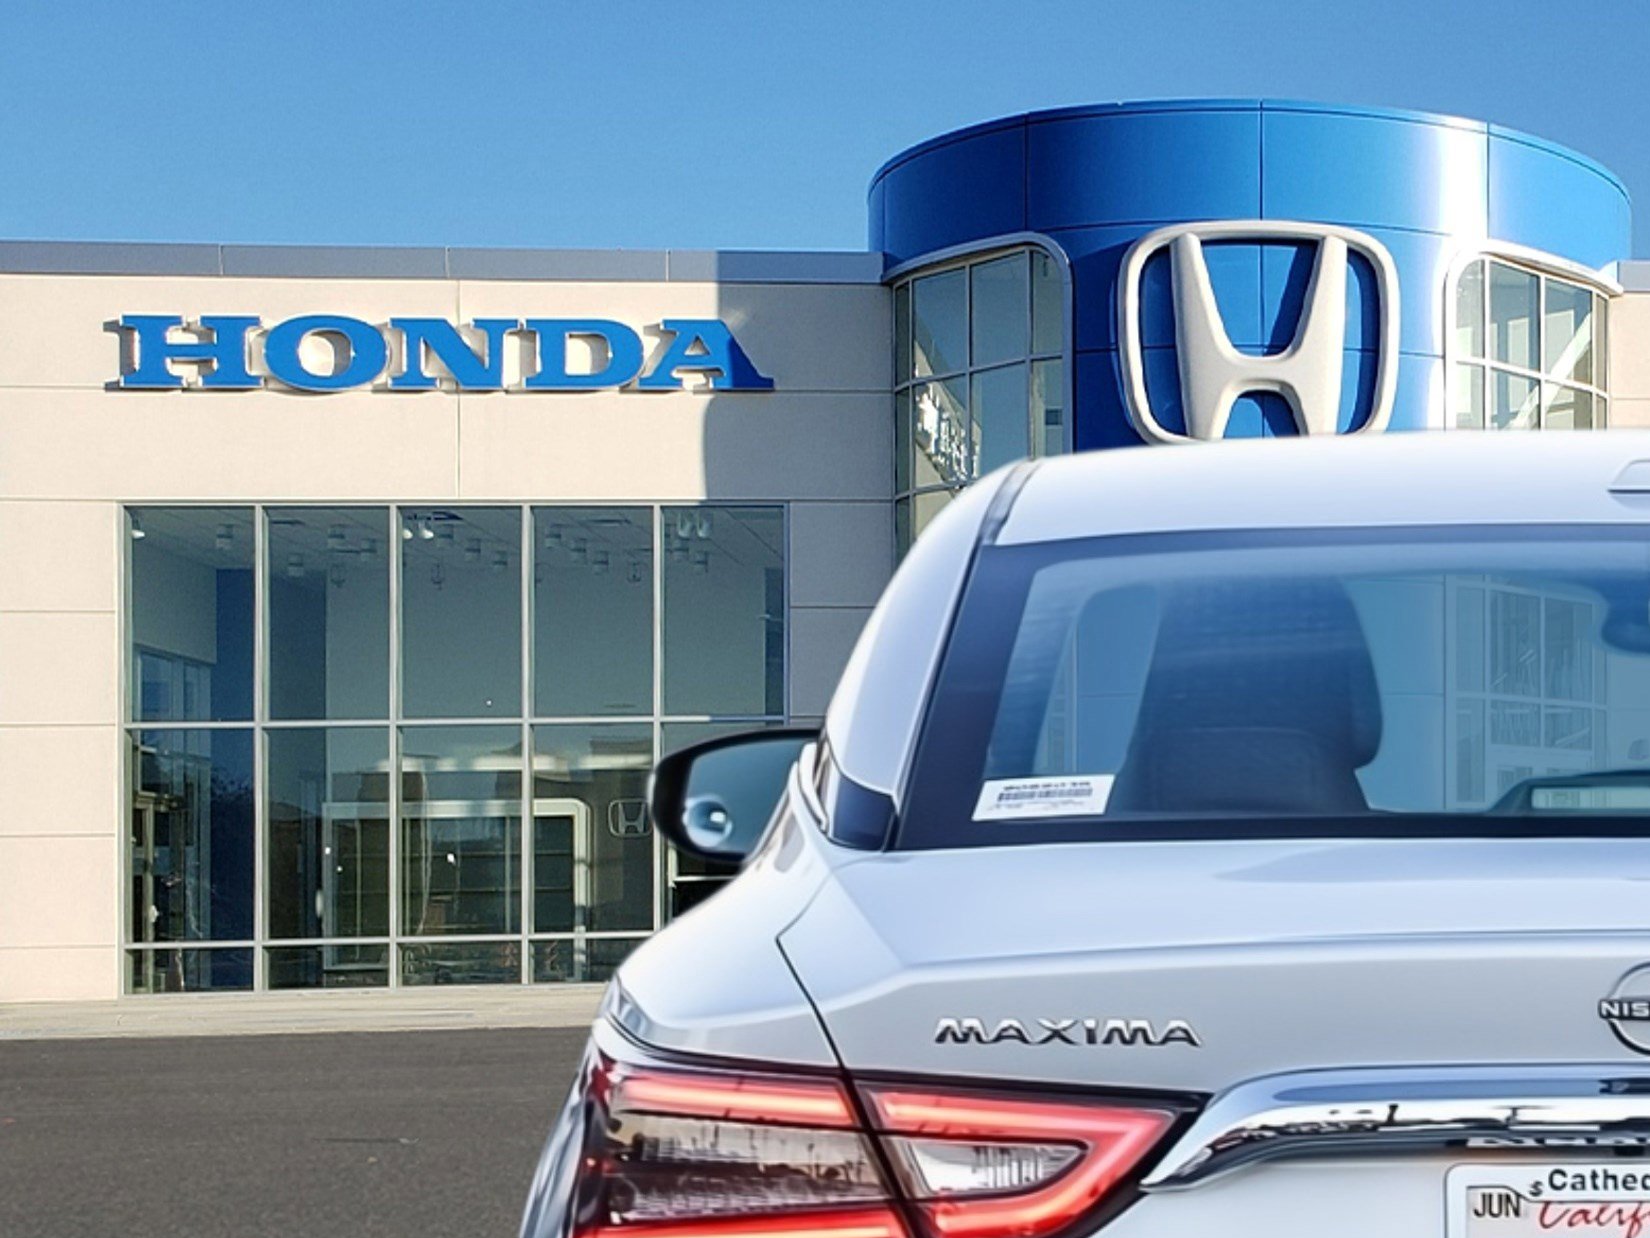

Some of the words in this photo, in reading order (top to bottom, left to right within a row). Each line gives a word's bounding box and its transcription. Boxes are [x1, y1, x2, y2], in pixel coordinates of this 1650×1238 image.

[118, 313, 775, 391] HONDA
[934, 1017, 1202, 1047] MAXIMA
[1472, 1191, 1521, 1219] JUN
